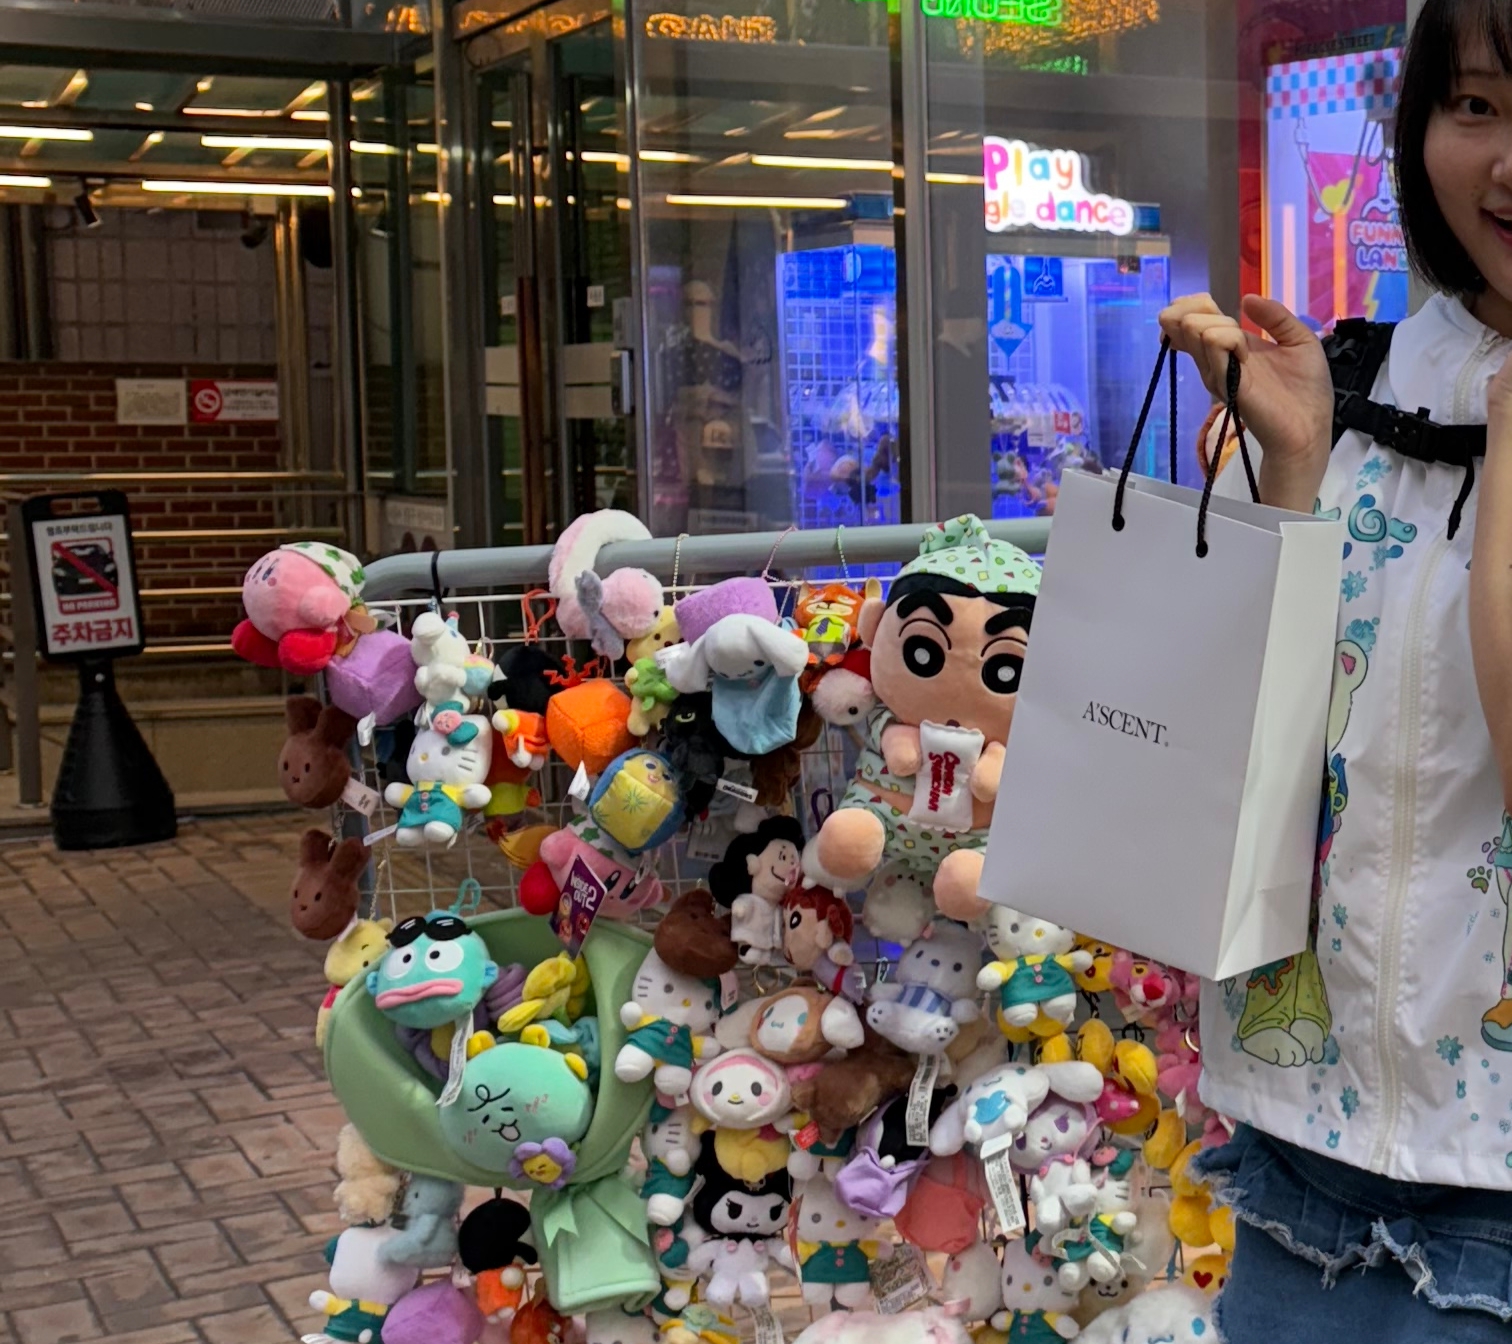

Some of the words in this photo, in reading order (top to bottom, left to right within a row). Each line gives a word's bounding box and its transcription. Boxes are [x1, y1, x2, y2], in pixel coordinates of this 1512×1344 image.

[983, 143, 1074, 191] Play
[1035, 190, 1127, 228] dance
[52, 616, 134, 646] 주차금지
